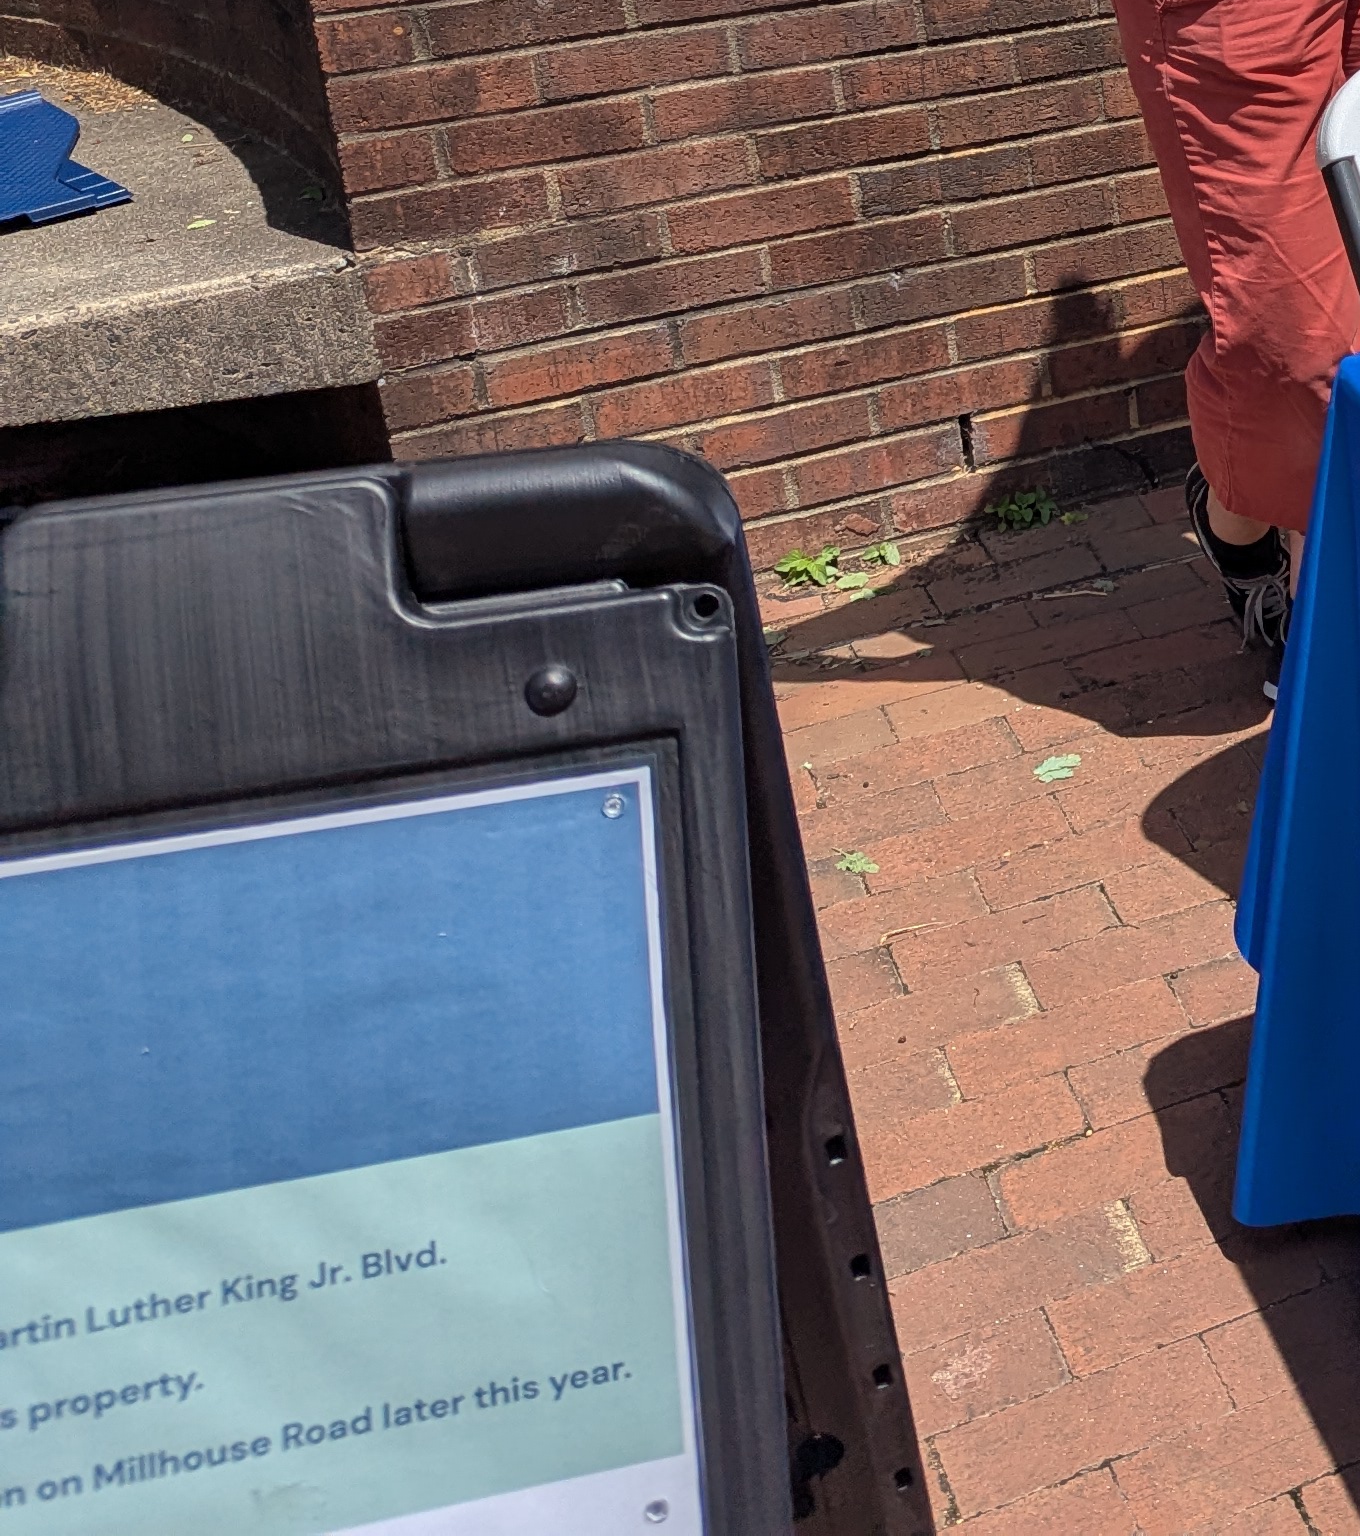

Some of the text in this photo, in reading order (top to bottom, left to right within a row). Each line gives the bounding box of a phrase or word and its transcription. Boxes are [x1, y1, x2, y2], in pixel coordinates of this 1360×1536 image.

[86, 1287, 213, 1333] Luther
[220, 1271, 299, 1304] King
[308, 1260, 354, 1290] Jr.
[361, 1240, 447, 1279] Blvd.
[28, 1370, 205, 1431] property.
[36, 1474, 84, 1502] on
[93, 1435, 272, 1490] Millhouse
[281, 1406, 373, 1450] Road
[382, 1392, 465, 1430] later
[473, 1377, 540, 1408] this
[549, 1361, 633, 1400] year.
